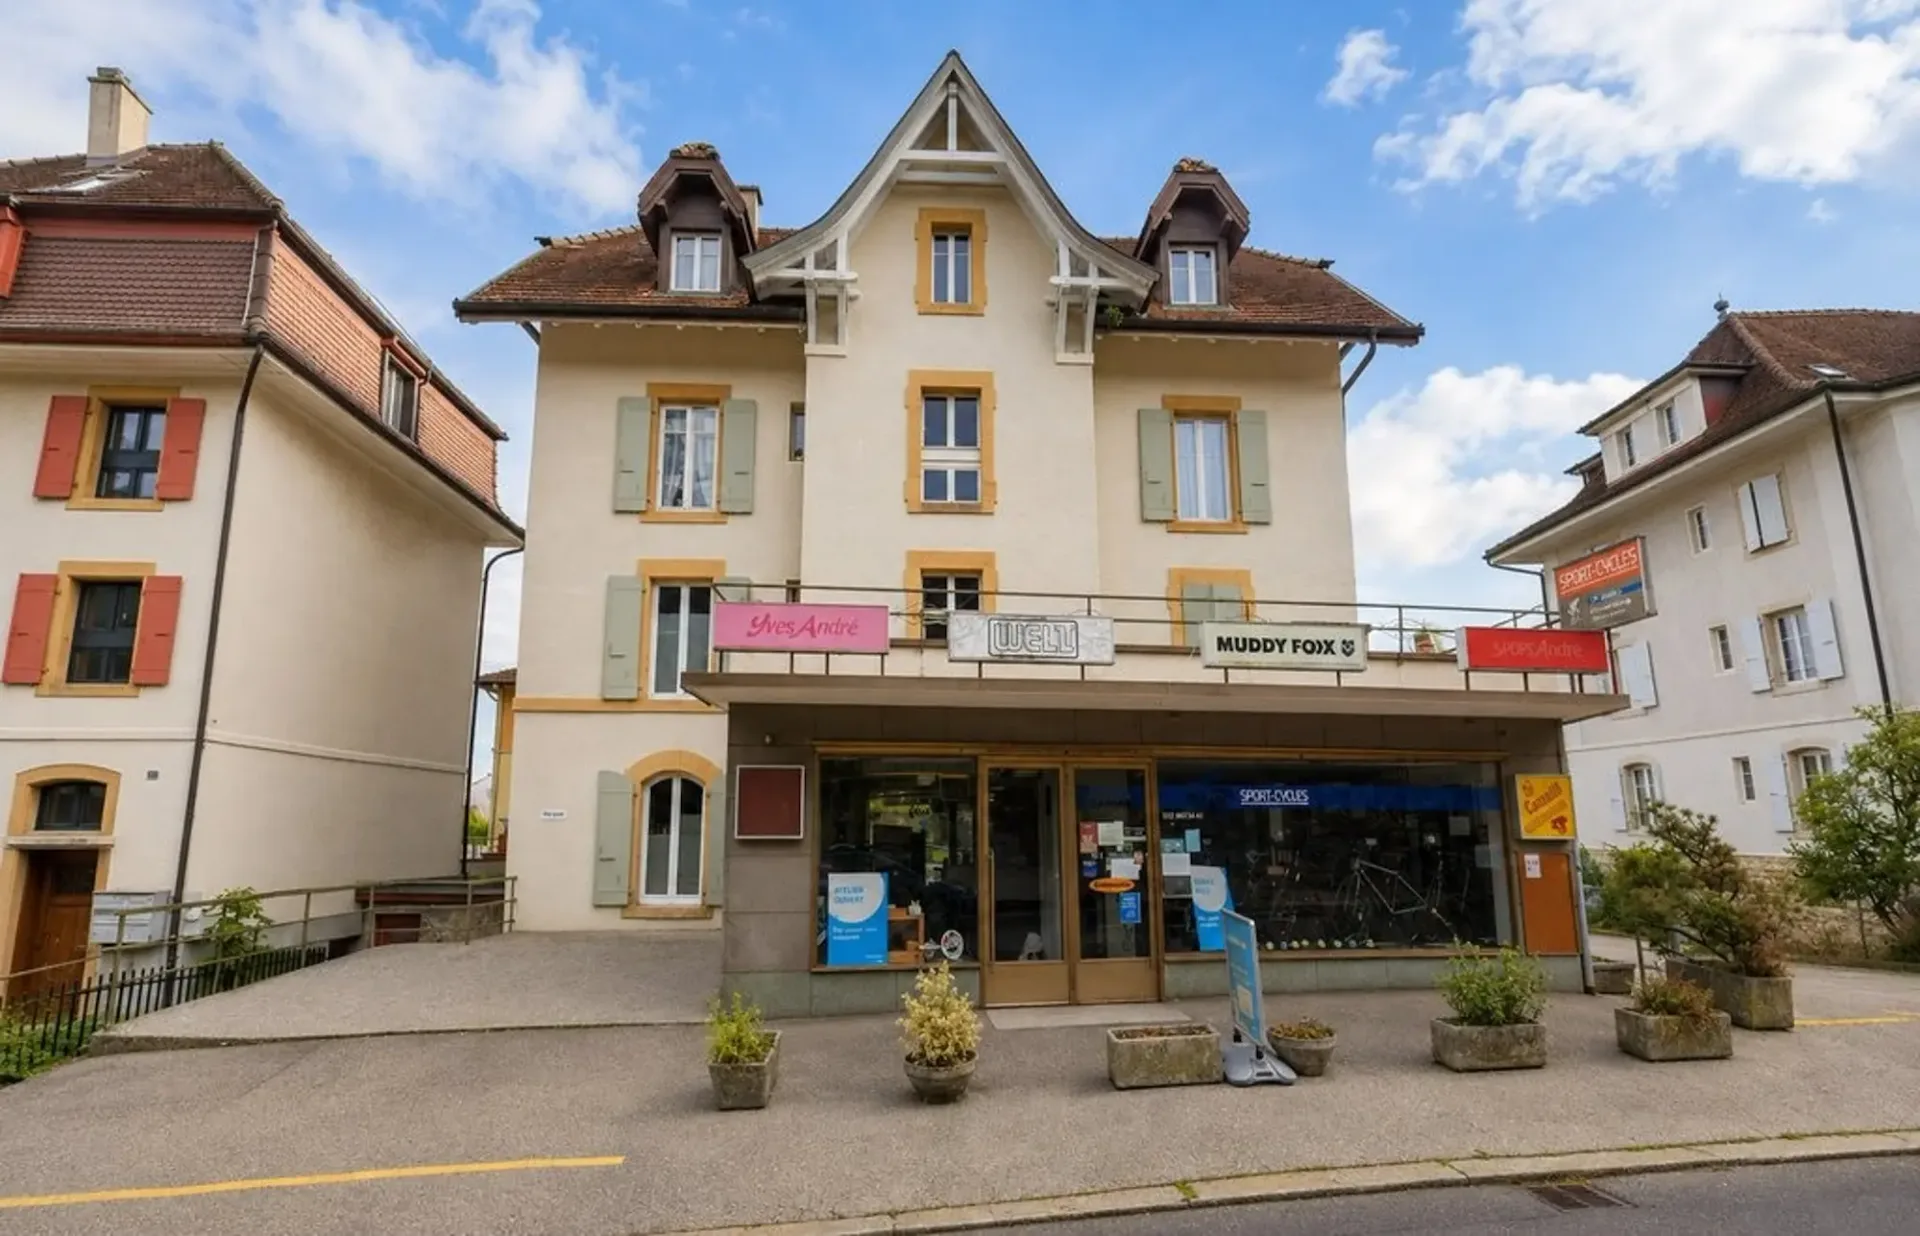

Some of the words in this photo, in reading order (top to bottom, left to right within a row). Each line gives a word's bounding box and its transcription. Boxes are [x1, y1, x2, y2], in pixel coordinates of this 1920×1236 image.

[1559, 546, 1638, 592] SPORT-CYCLES
[746, 612, 796, 637] Yves
[1216, 636, 1287, 654] MUDDY
[1292, 639, 1337, 656] FOX
[1239, 789, 1310, 803] SPORT-CYCLES
